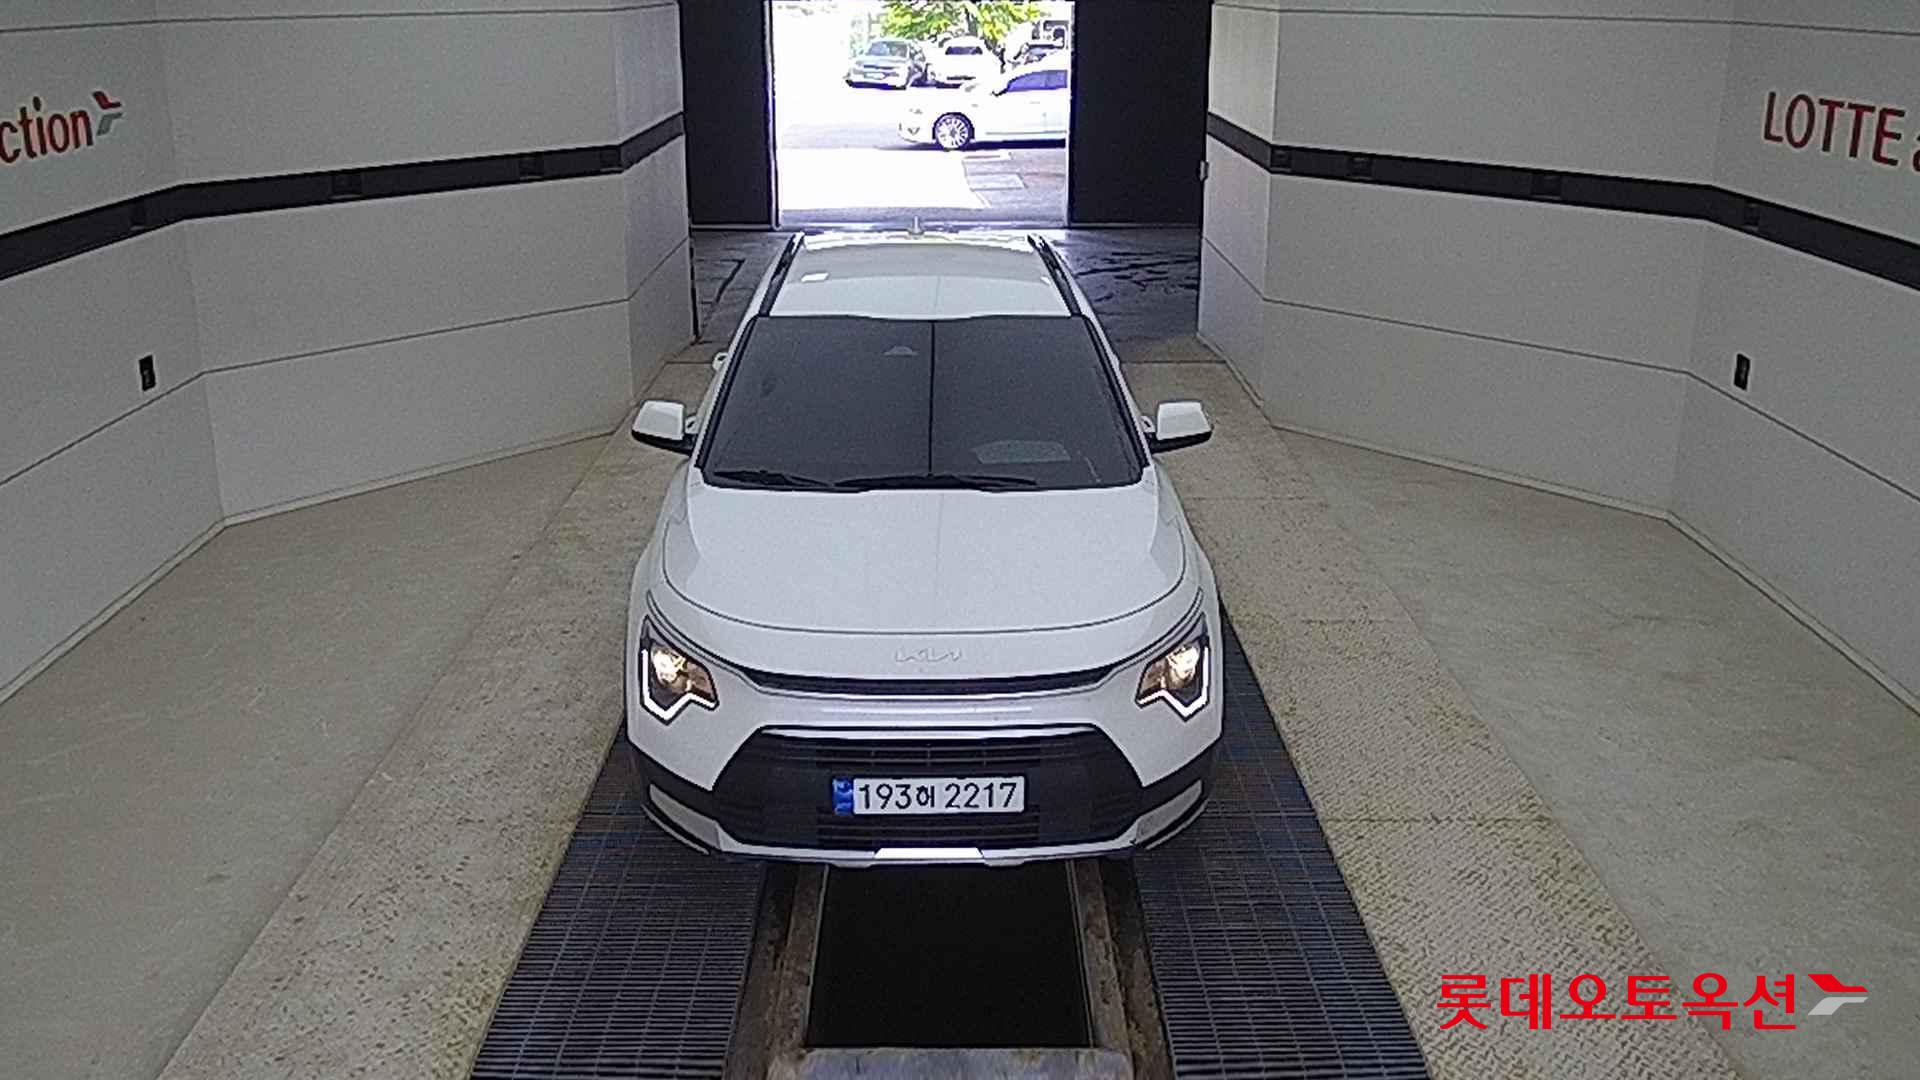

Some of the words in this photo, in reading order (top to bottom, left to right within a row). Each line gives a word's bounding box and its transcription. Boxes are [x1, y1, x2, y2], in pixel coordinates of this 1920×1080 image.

[0, 96, 94, 163] ction
[1764, 91, 1905, 166] LOTTE
[859, 783, 935, 809] 193허
[945, 782, 1017, 809] 2217
